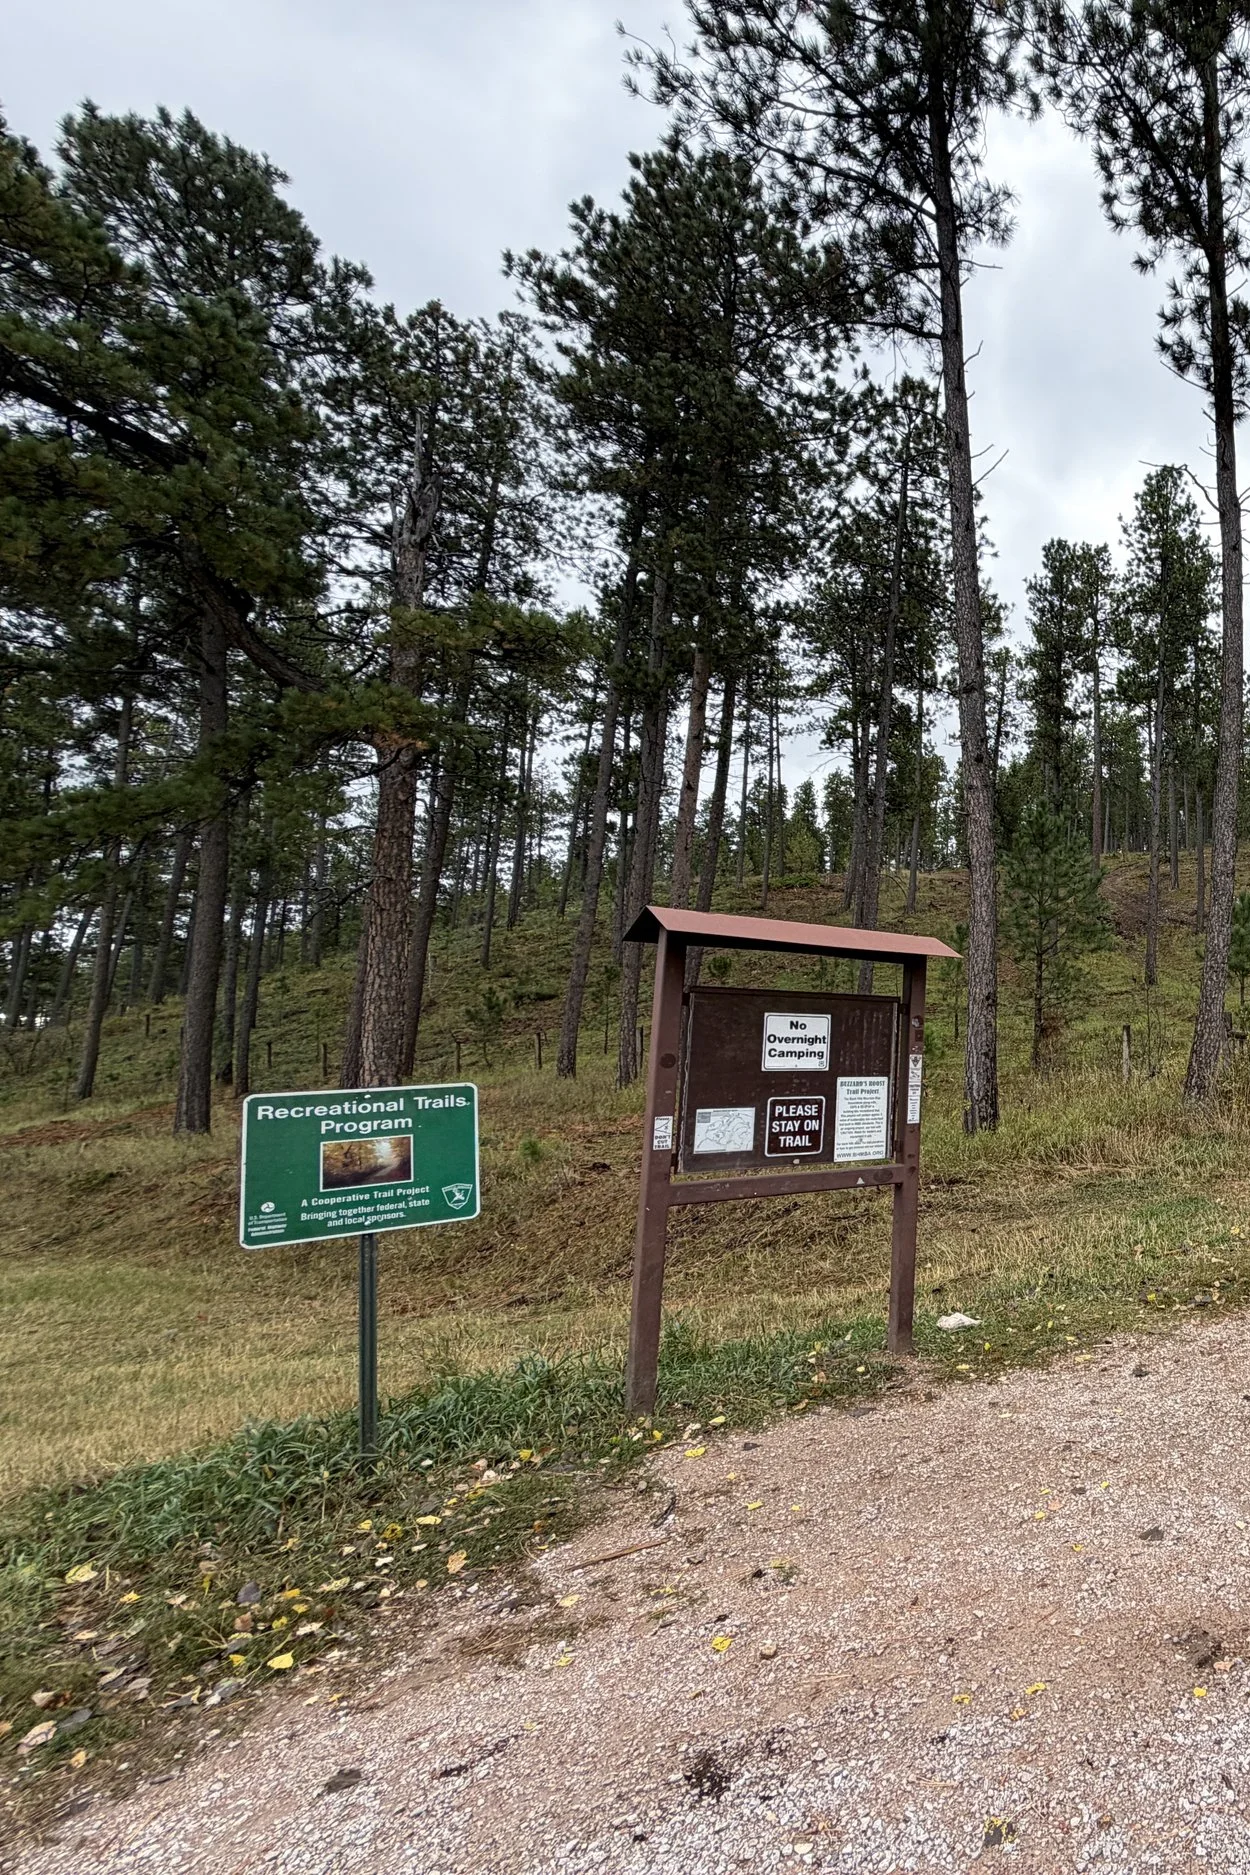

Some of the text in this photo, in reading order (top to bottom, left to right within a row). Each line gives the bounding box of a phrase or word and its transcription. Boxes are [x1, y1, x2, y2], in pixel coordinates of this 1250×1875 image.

[789, 1020, 807, 1030] No
[767, 1034, 827, 1047] Overnight
[768, 1048, 824, 1060] Camping
[860, 1088, 880, 1096] Project
[257, 1094, 467, 1120] Recreational Trails
[775, 1104, 818, 1116] PLEASE
[320, 1117, 412, 1135] Program
[772, 1120, 819, 1133] STAY ON
[779, 1135, 812, 1148] TRAIL
[301, 1185, 430, 1207] A Cooperative Trail Project
[300, 1198, 430, 1221] Bringing together federal, state
[327, 1218, 343, 1228] and
[345, 1215, 365, 1225] local
